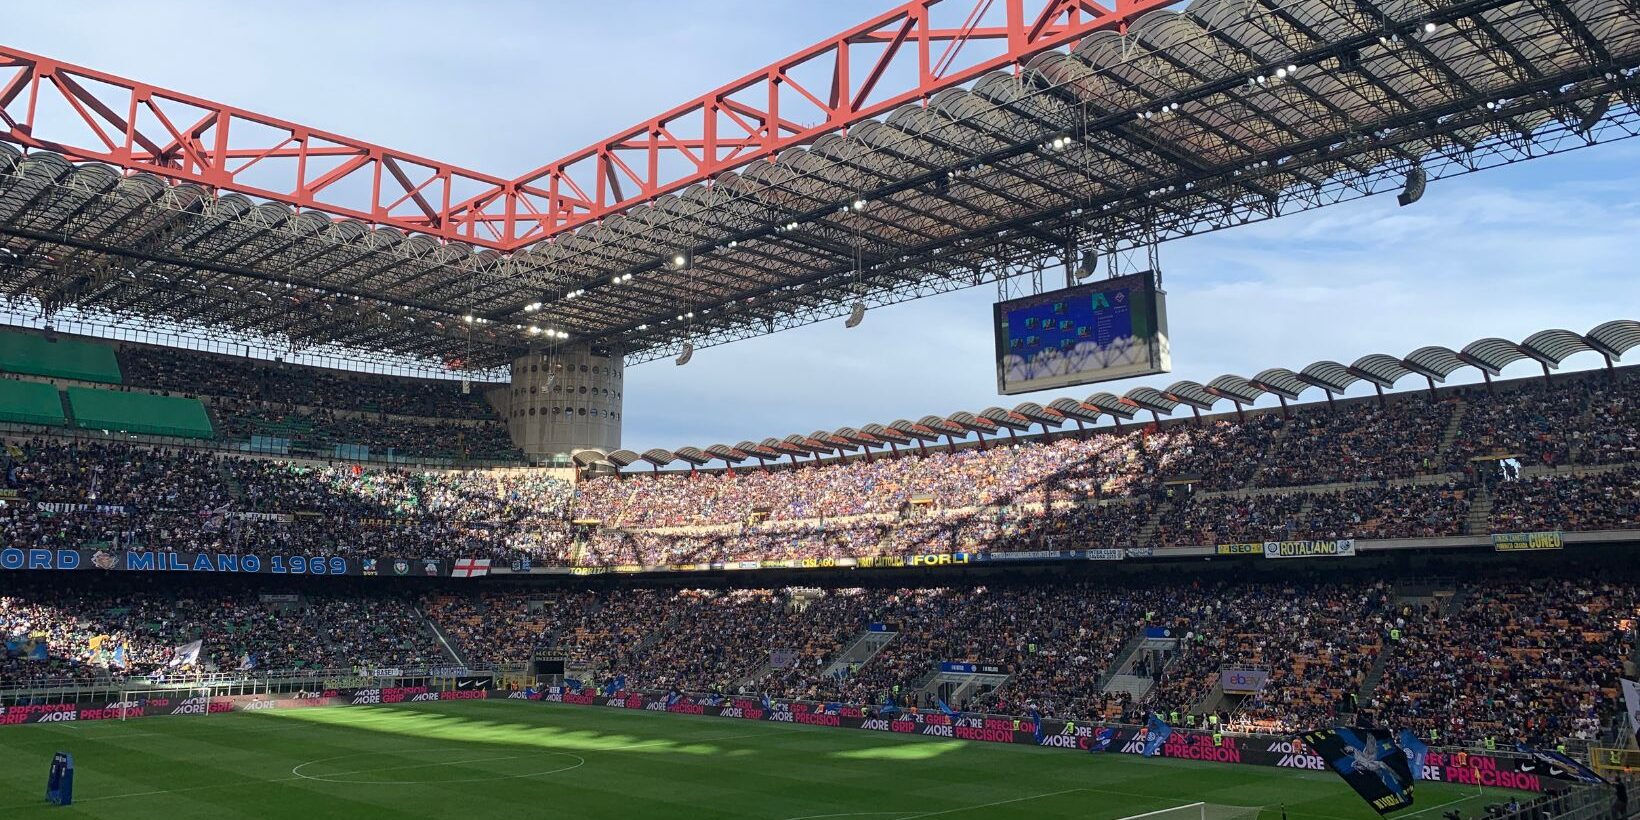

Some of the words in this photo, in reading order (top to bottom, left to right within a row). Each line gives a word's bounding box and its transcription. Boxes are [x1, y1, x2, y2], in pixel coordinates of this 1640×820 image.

[1529, 533, 1560, 548] CUNEO
[1281, 541, 1336, 555] ROTALIANO
[127, 551, 261, 573] MILANO
[271, 555, 347, 574] 1969
[914, 553, 969, 566] FORLI
[570, 567, 606, 575] TORRITA
[1230, 674, 1261, 686] ebay
[351, 695, 380, 704] MORE
[382, 694, 405, 703] GRIP
[411, 692, 439, 701] MORE
[441, 690, 487, 700] PRECISION
[546, 693, 562, 701] MORE
[244, 701, 275, 710] MORE
[606, 698, 624, 707] MORE
[646, 701, 666, 711] MORE
[38, 711, 76, 722] MORE
[80, 707, 144, 720] PRECISION
[171, 704, 206, 715] MORE
[720, 708, 743, 717] MORE
[744, 709, 763, 719] GRIP
[769, 711, 793, 721] MORE
[795, 712, 839, 726] PRECISION
[861, 719, 889, 730] MORE
[891, 721, 915, 733] GRIP
[985, 719, 1035, 733] PRECIION
[922, 725, 953, 737] MORE
[955, 726, 1013, 743] PRECISION
[1040, 735, 1076, 748] MORE
[1266, 742, 1307, 754] MOE
[1120, 741, 1161, 755] MOE
[1164, 743, 1240, 762] PRECISION
[1275, 754, 1325, 770] MORE
[1445, 766, 1540, 791] PRECISION
